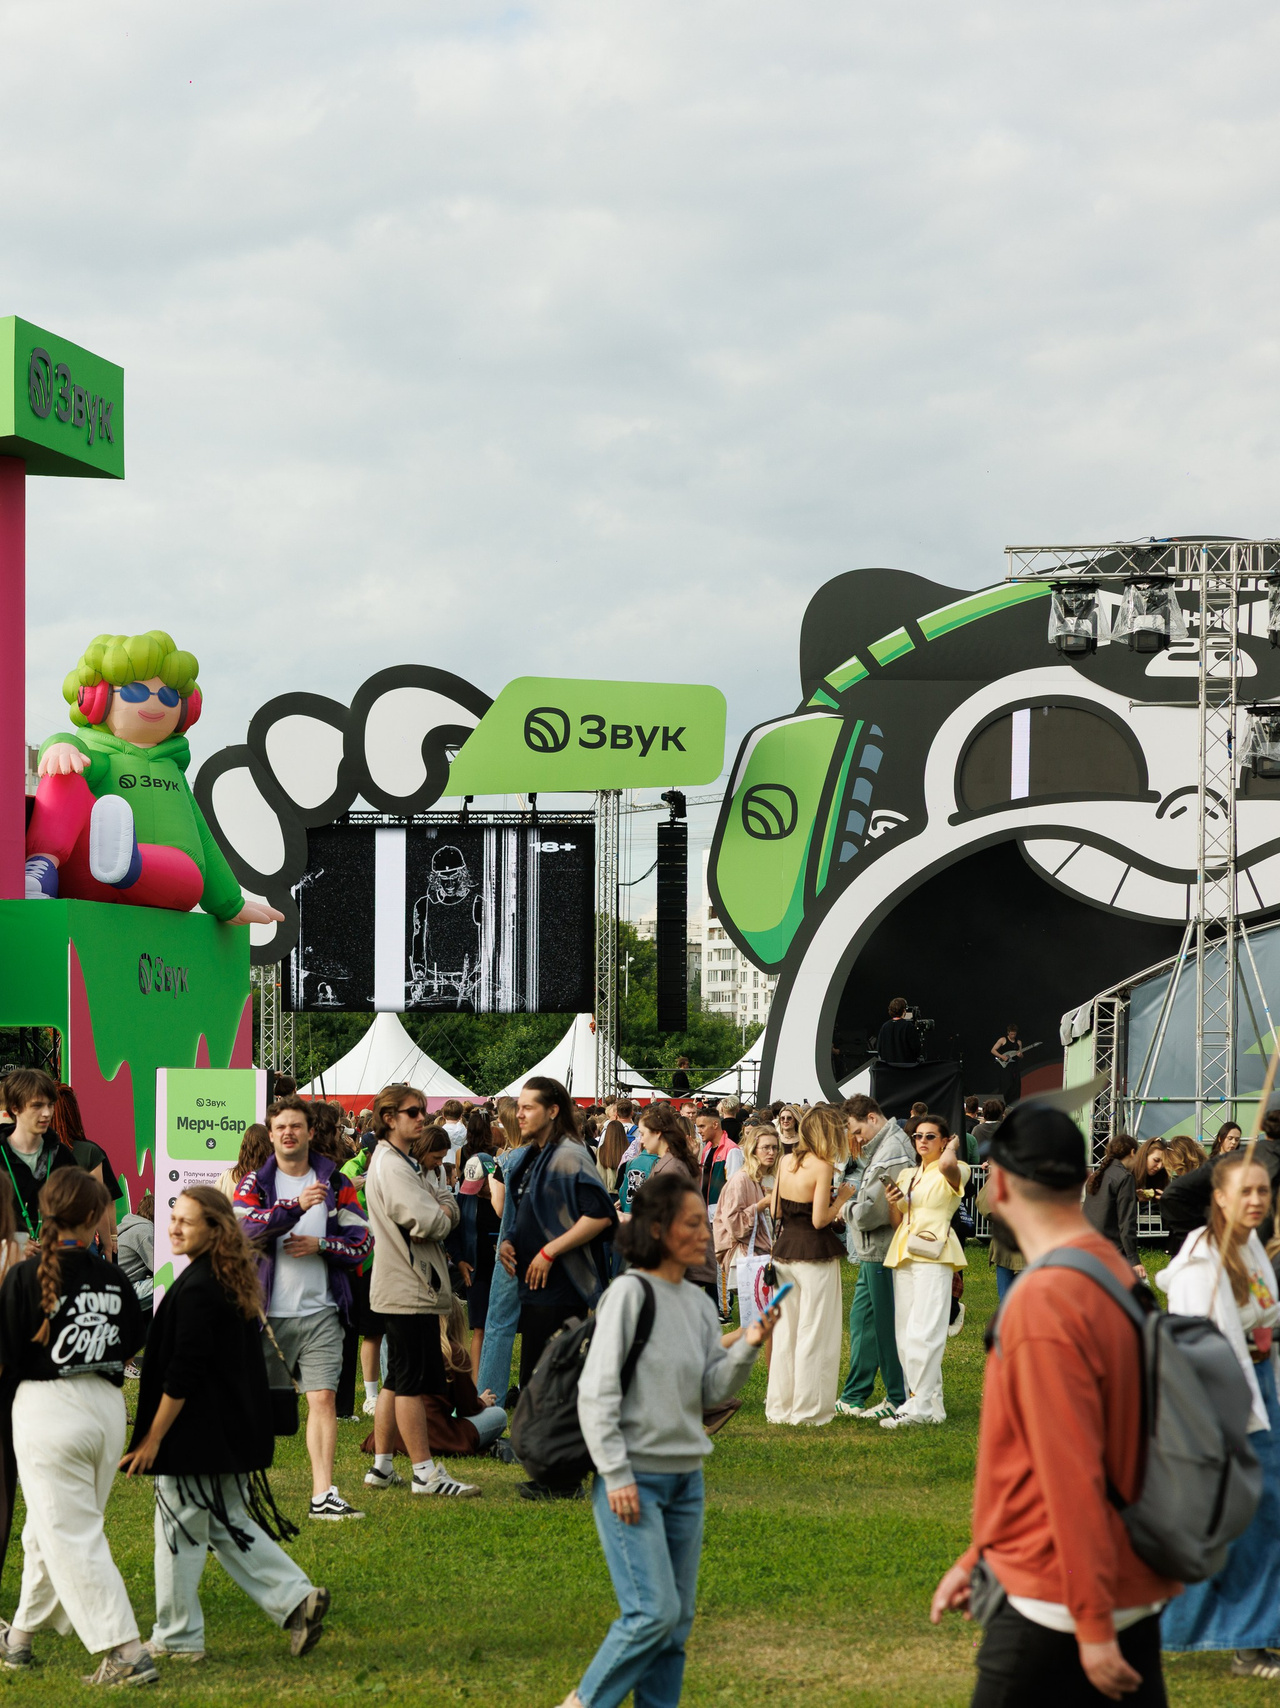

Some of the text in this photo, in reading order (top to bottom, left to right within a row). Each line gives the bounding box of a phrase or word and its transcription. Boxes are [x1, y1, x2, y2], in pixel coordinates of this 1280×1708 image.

[55, 362, 115, 446] Звук
[578, 714, 687, 758] Звук
[139, 774, 180, 792] Звук
[529, 841, 577, 853] 18+
[154, 956, 189, 999] Звук
[205, 1098, 227, 1108] Звук
[176, 1115, 247, 1134] Мерч-бар
[50, 1322, 121, 1364] Coffe
